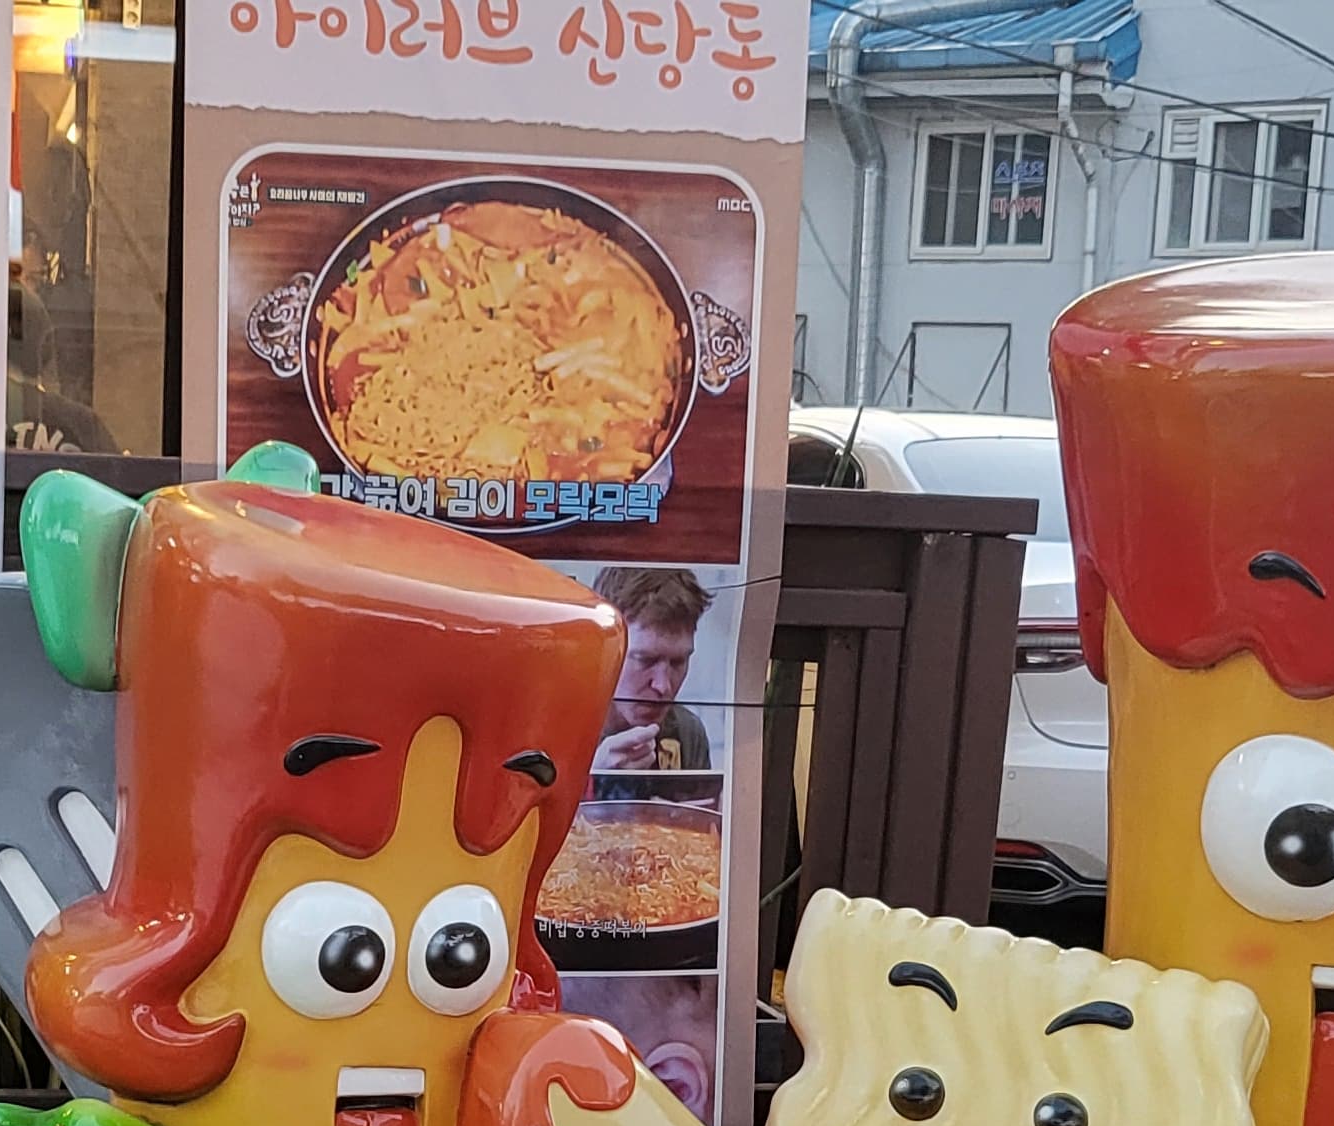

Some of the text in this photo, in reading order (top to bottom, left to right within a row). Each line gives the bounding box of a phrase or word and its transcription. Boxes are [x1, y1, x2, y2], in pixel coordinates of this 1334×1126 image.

[230, 0, 777, 101] 아이러브 신당동
[364, 474, 436, 517] 끓여
[446, 478, 515, 519] 김이
[523, 481, 662, 523] 모락모락
[539, 919, 567, 938] 비법
